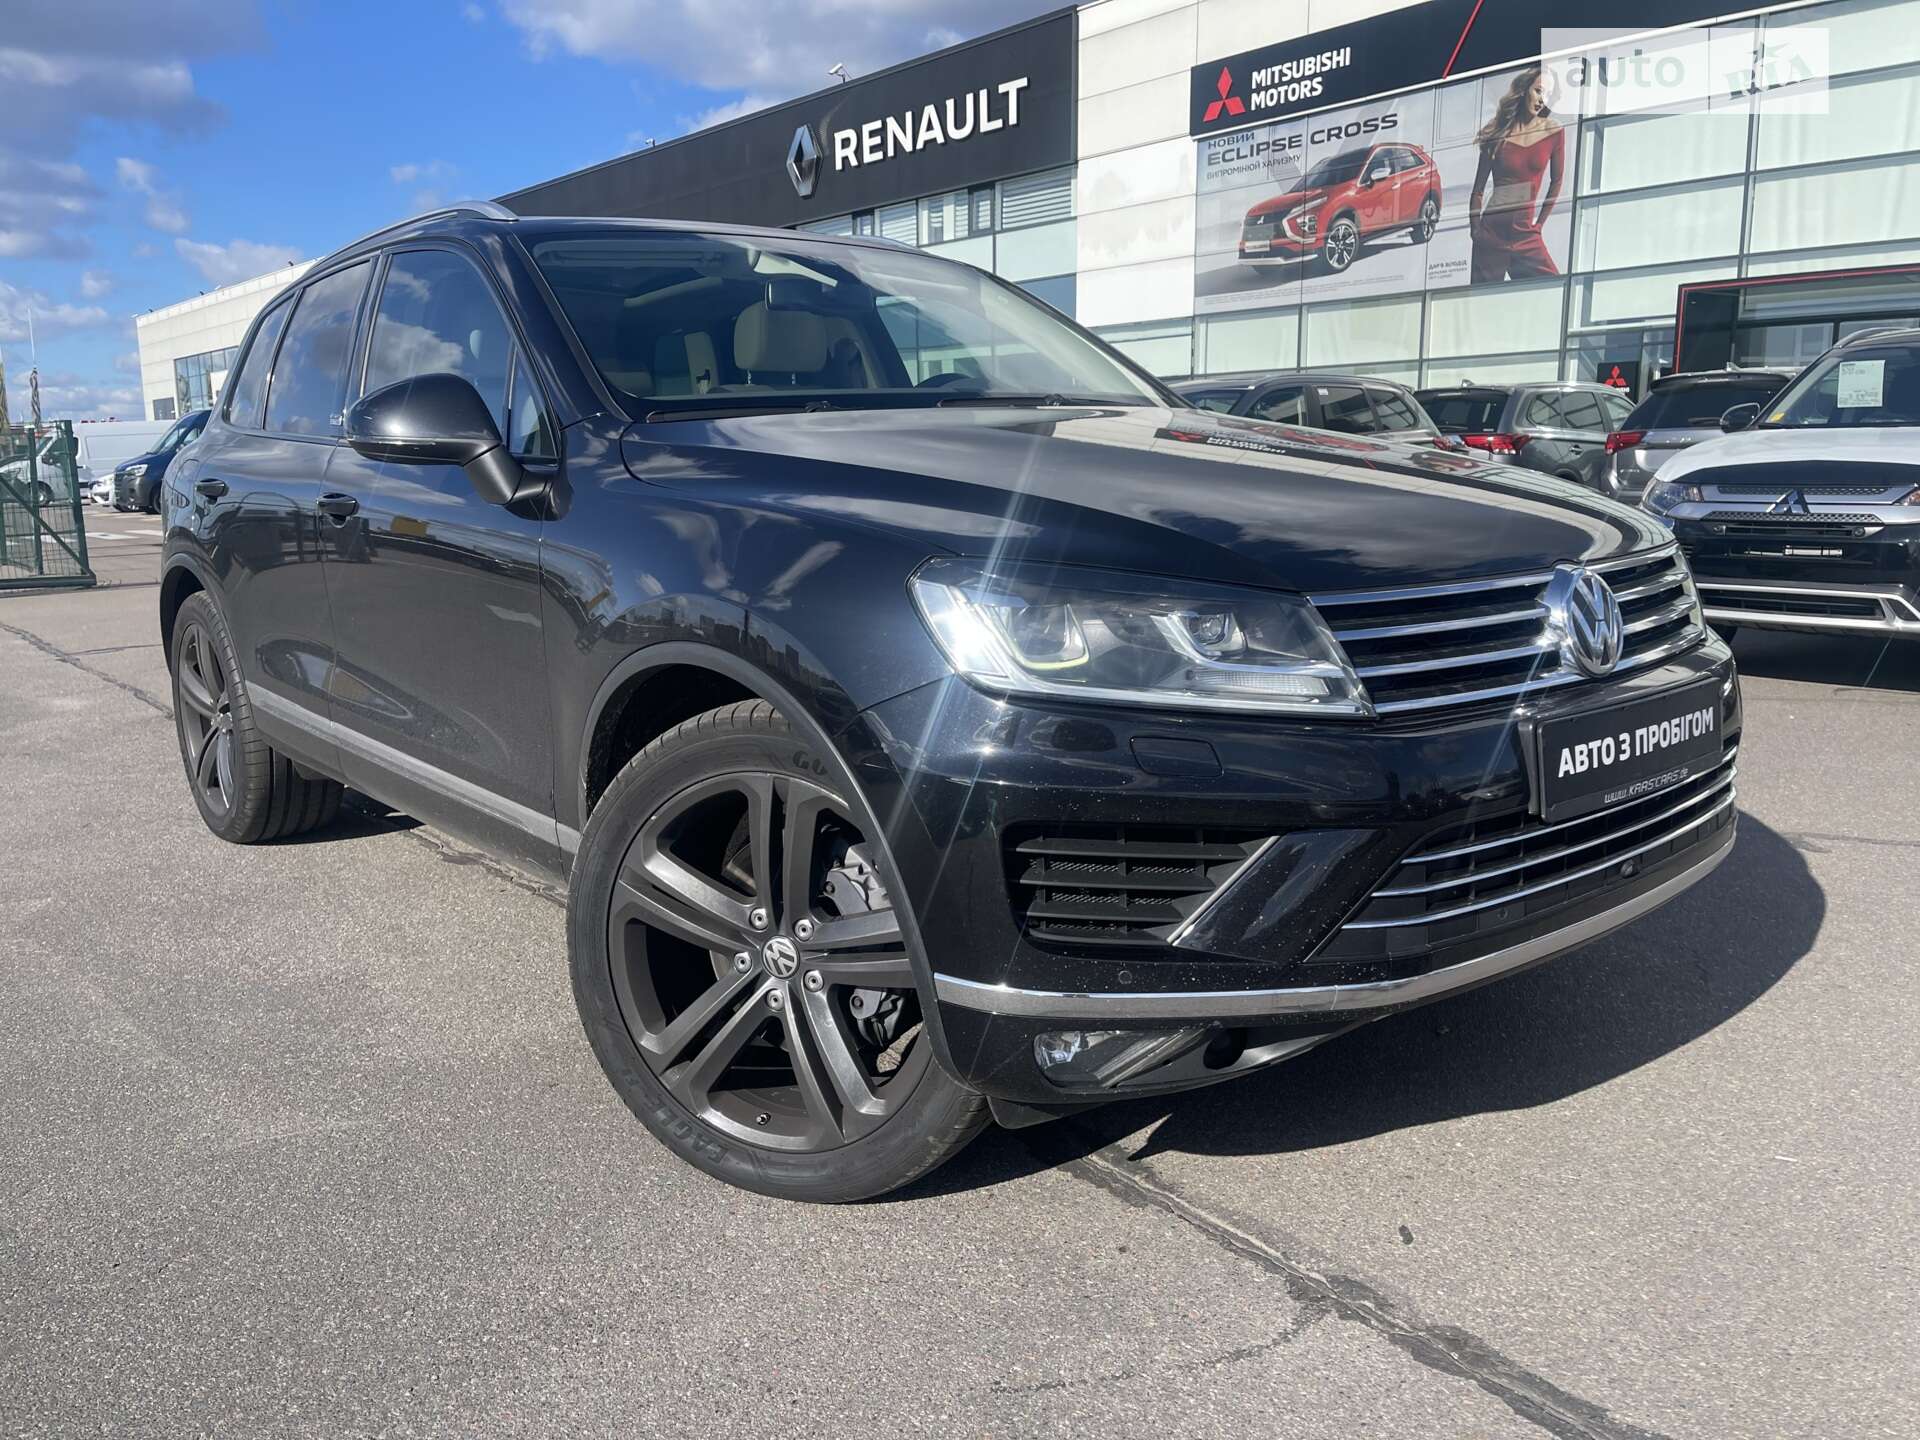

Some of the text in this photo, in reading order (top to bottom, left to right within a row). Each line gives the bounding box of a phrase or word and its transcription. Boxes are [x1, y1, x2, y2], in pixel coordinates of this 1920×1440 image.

[1251, 46, 1351, 89] MITSUBISHI
[1251, 77, 1323, 111] MOTORS
[834, 77, 1028, 171] RENAULT
[1207, 113, 1398, 167] ECLIPSE CROSS
[1558, 706, 1714, 778] АВТО З ПРОБІГОМ
